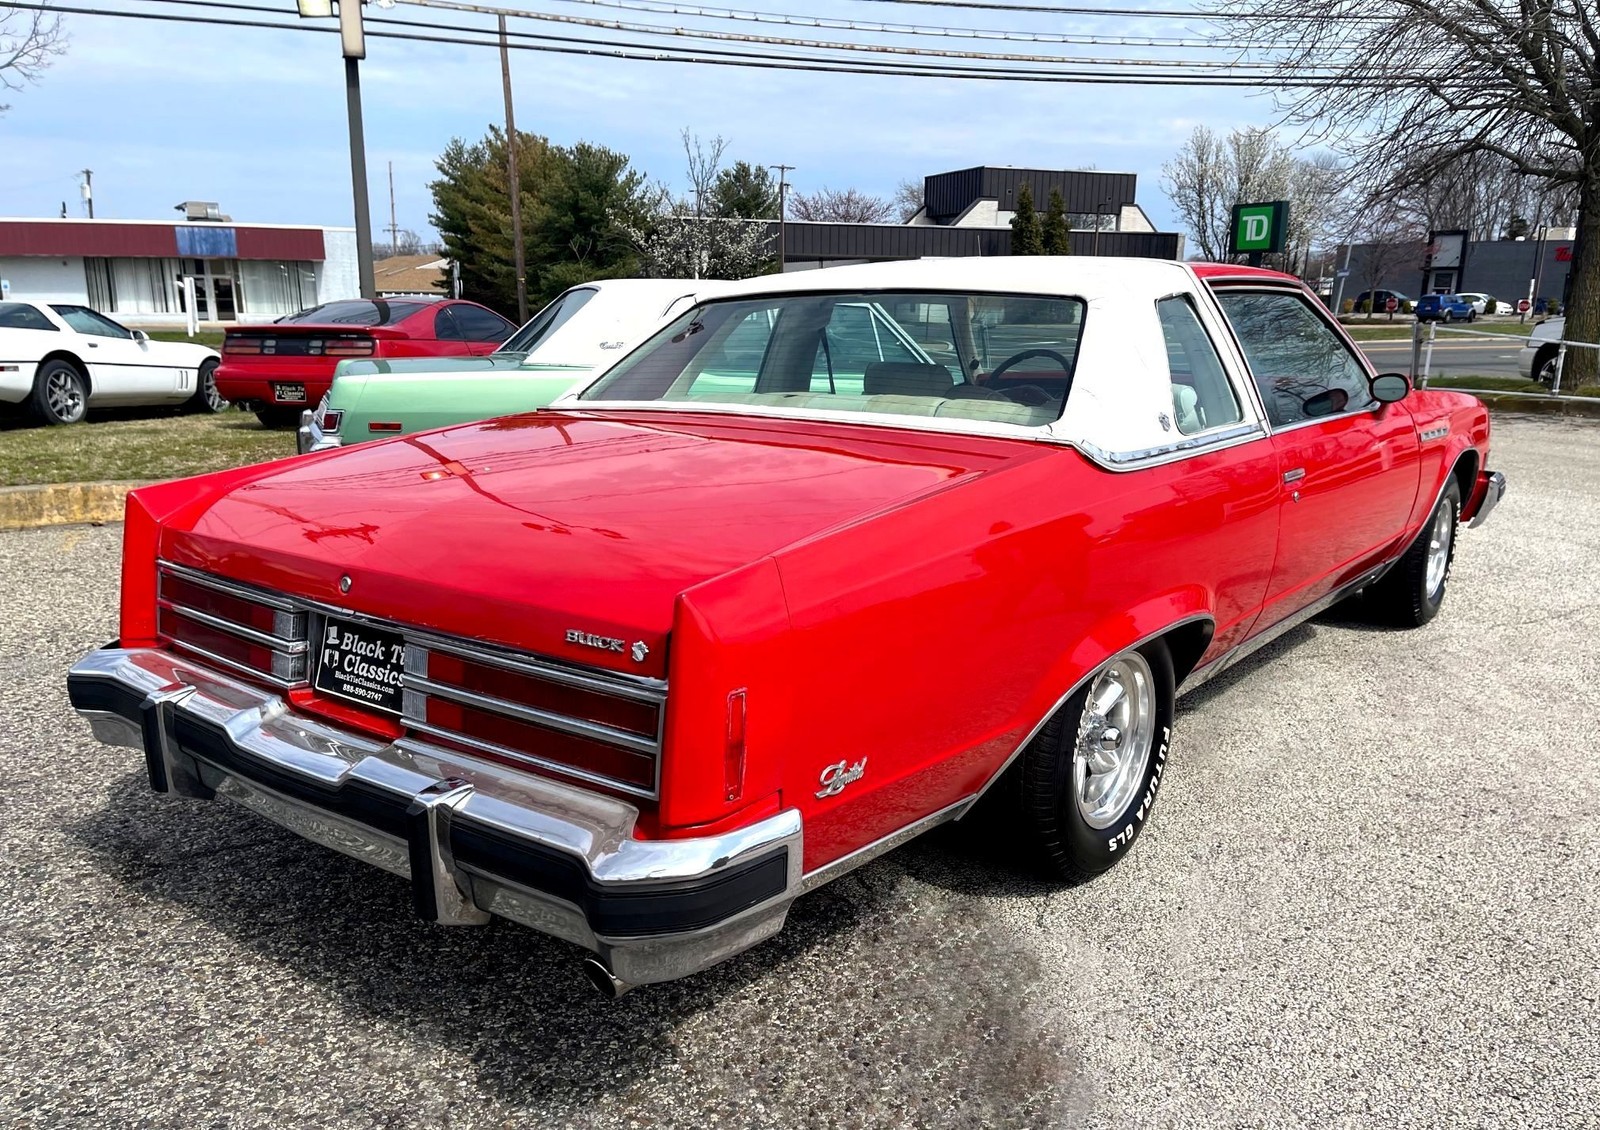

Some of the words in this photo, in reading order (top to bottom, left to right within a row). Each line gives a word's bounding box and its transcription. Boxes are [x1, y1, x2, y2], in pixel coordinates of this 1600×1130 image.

[1242, 215, 1269, 241] TD
[340, 632, 386, 660] Black
[390, 644, 405, 665] Ti
[565, 629, 625, 652] BUICK
[334, 670, 395, 694] BlackTieClassics.com
[343, 654, 404, 687] Classics
[342, 683, 382, 701] 888-590-2747
[1136, 726, 1171, 822] FUTURA
[1108, 823, 1134, 852] GLS
